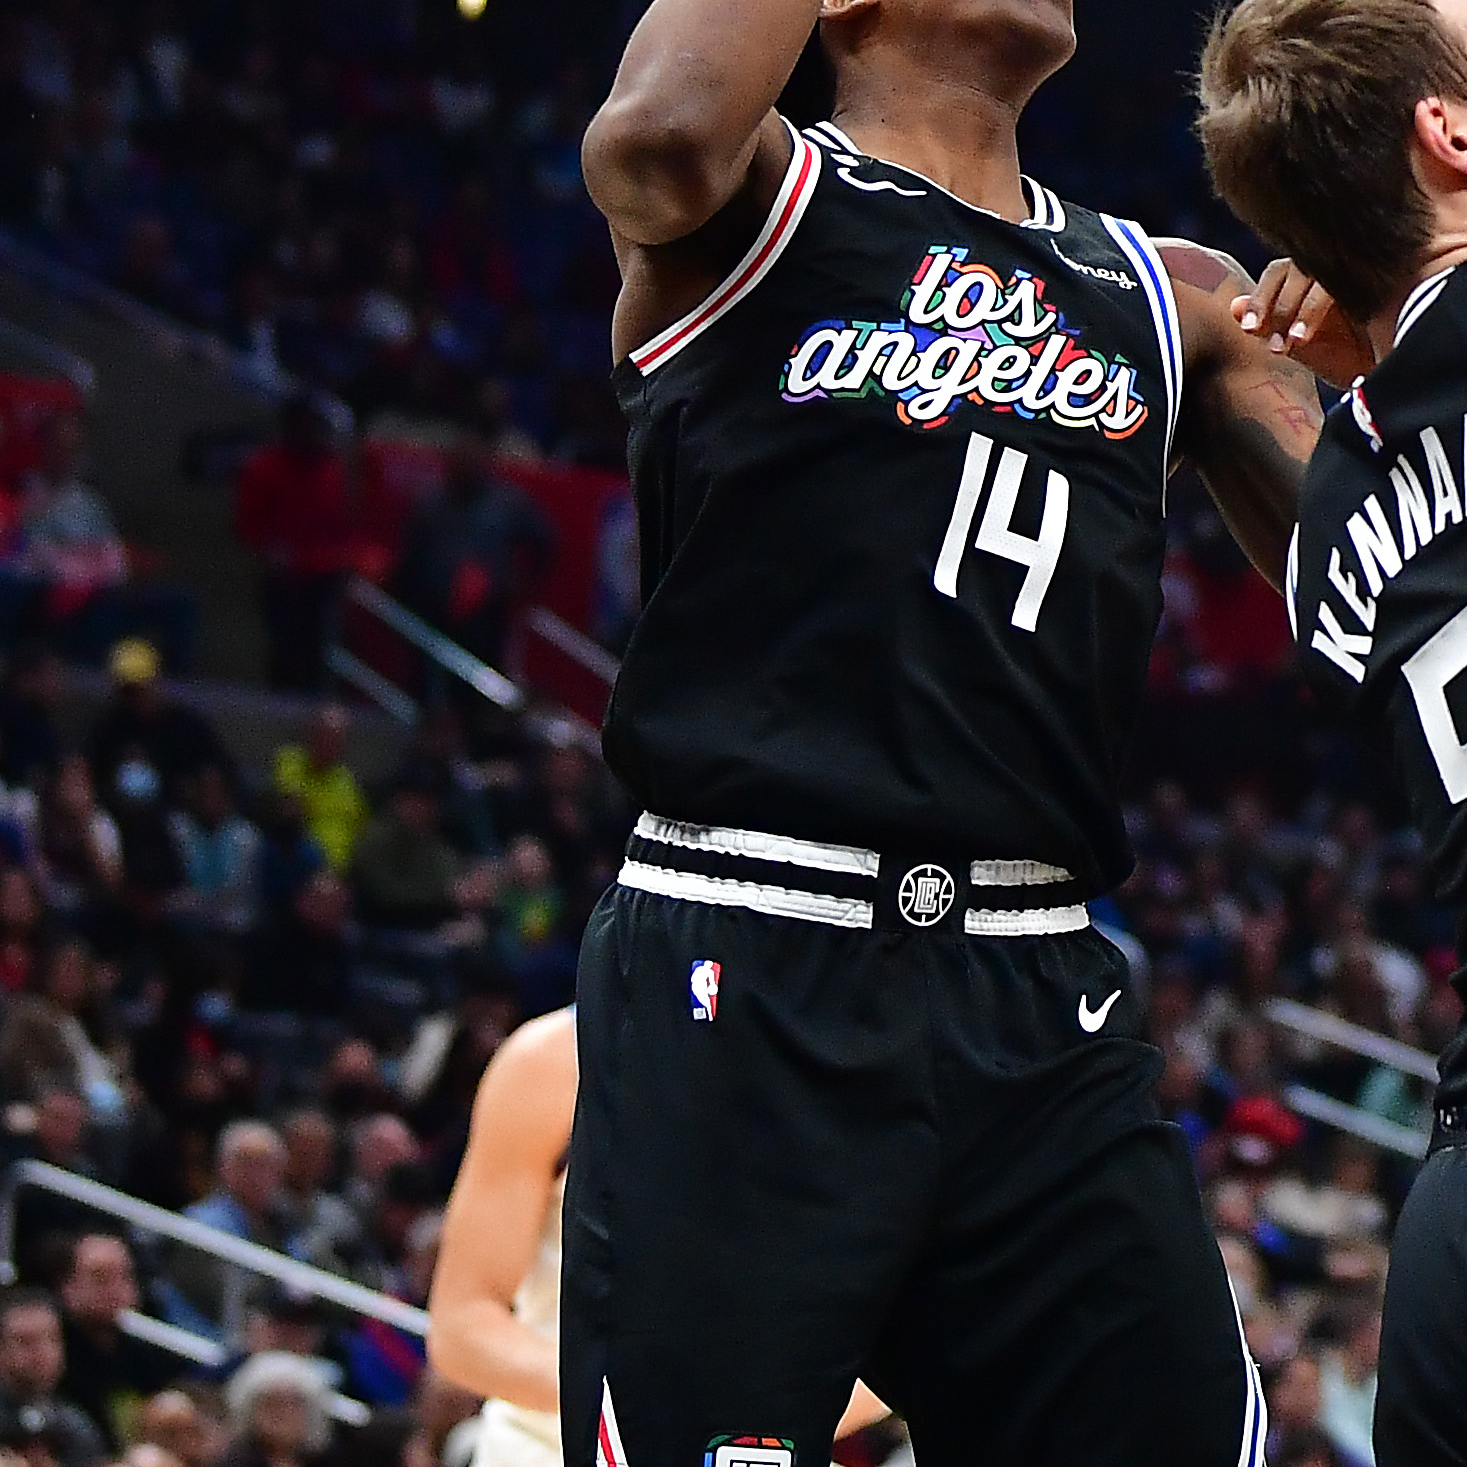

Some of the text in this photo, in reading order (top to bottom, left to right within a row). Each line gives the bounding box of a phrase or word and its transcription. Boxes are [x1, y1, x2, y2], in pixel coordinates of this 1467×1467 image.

[907, 252, 1056, 335] los
[786, 324, 1144, 432] angeles
[933, 431, 1070, 632] 14
